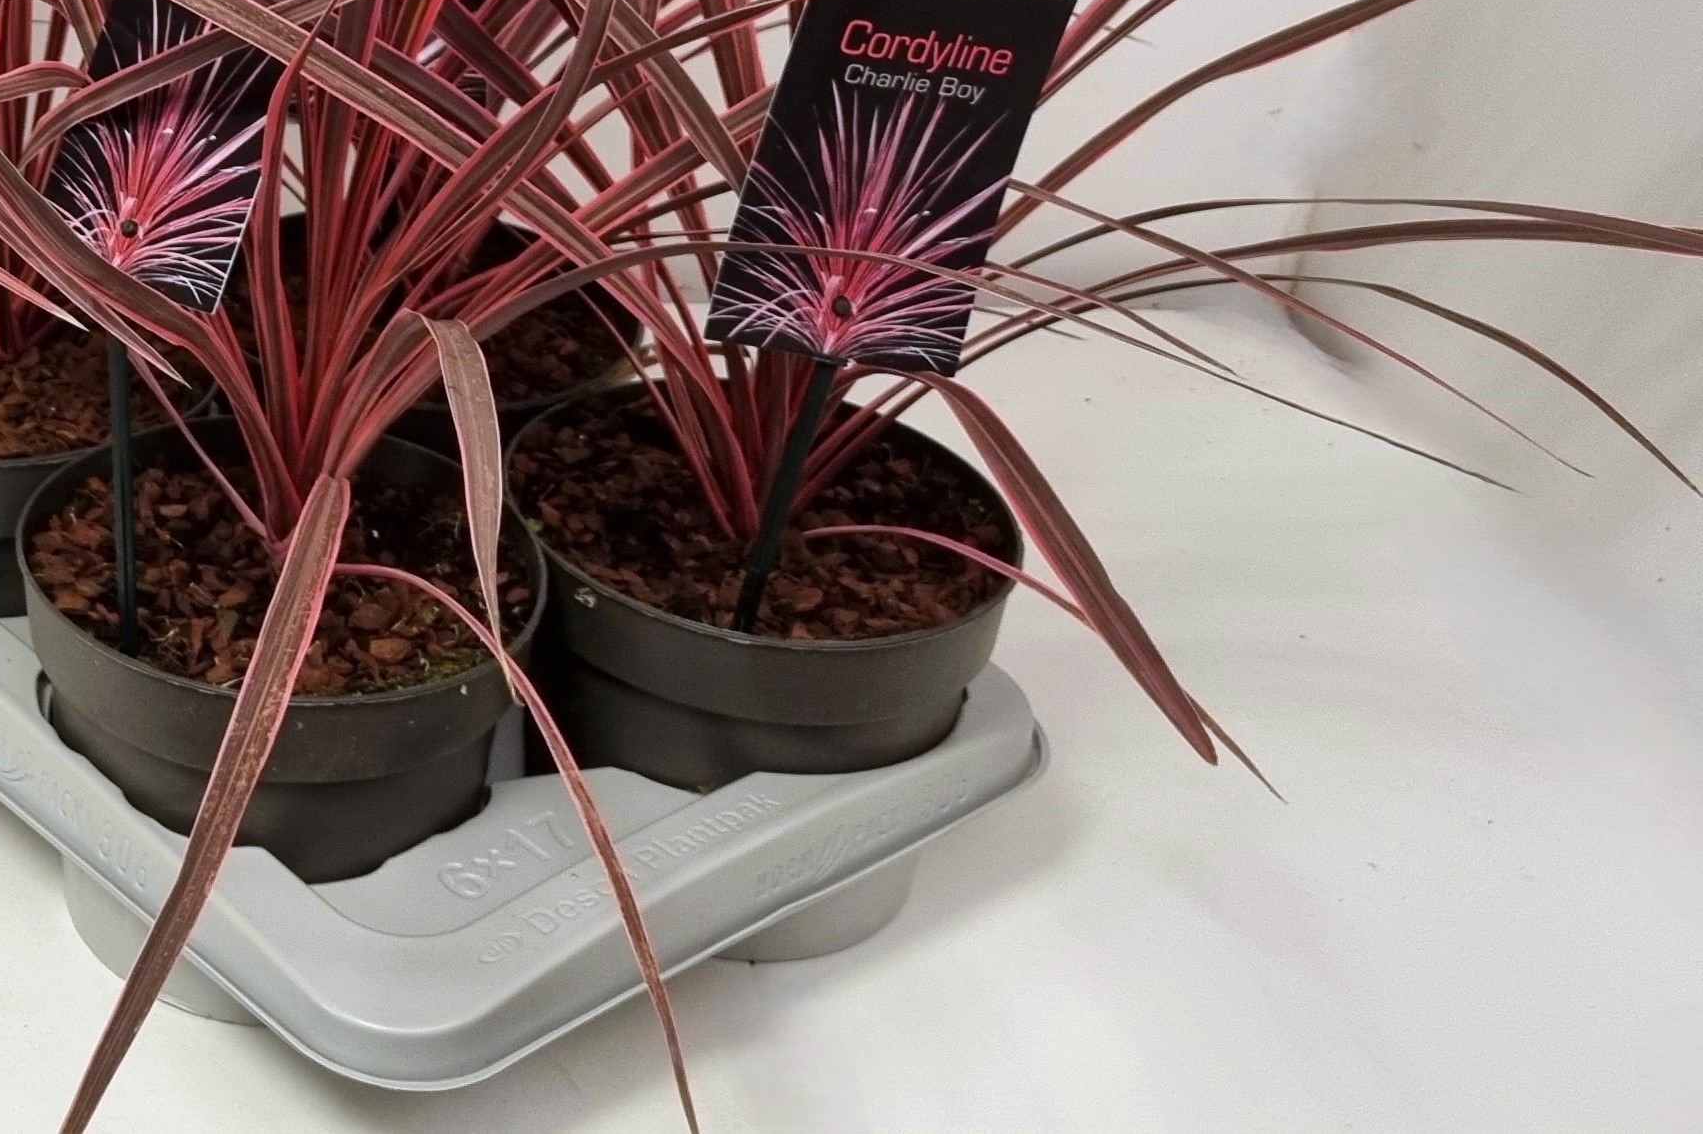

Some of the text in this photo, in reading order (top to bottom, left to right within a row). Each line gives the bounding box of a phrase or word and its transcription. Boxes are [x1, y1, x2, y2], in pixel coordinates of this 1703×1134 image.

[840, 19, 1014, 75] Cordyline
[844, 63, 986, 105] Charlie Boy
[522, 869, 638, 936] Desc
[631, 792, 782, 871] Plantpak
